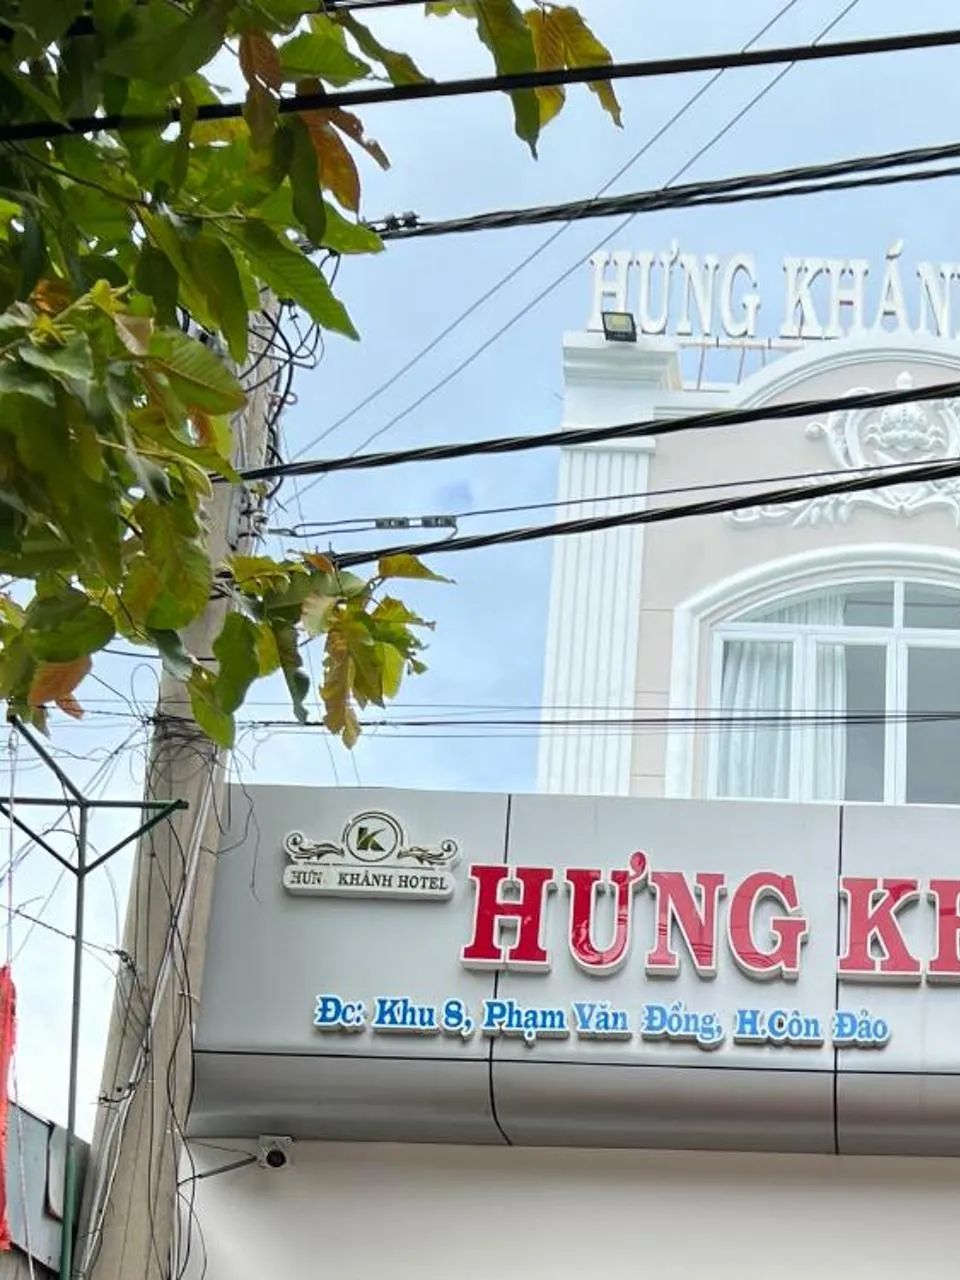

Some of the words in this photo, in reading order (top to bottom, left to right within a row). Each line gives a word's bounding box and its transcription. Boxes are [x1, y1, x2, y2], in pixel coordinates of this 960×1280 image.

[587, 238, 760, 338] HƯNG
[356, 827, 386, 851] K
[338, 869, 392, 887] KHÁNH
[398, 873, 449, 890] HOTEL
[462, 851, 808, 978] HƯNG
[315, 994, 364, 1026] Đc:
[373, 997, 437, 1029] Khu
[443, 999, 475, 1034] 8,
[482, 999, 567, 1040] Phạm
[573, 1001, 630, 1032] Văn
[734, 1008, 822, 1039] H.Côn
[833, 1006, 890, 1040] Đảo
